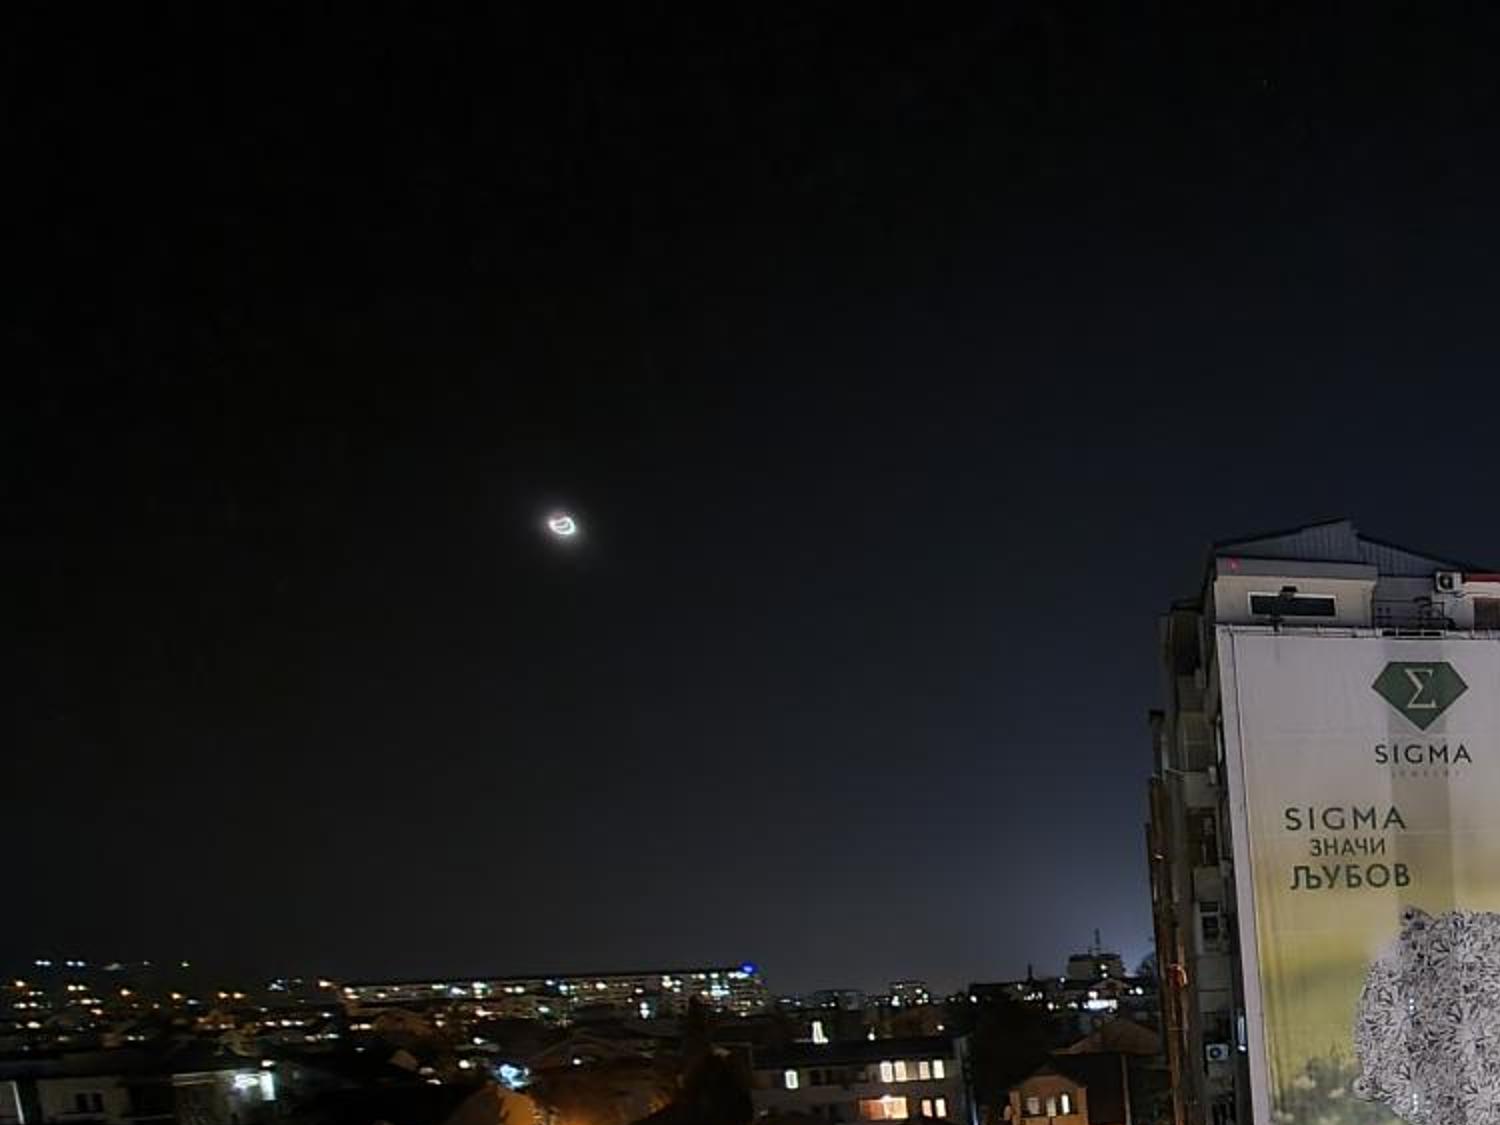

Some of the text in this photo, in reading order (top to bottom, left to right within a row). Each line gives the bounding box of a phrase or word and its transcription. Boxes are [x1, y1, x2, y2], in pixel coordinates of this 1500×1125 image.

[1375, 744, 1472, 764] SIGMA
[1285, 806, 1406, 831] SIGMA
[1310, 838, 1385, 857] ЗНАЧИ
[1290, 863, 1410, 890] ЉУБОВ
